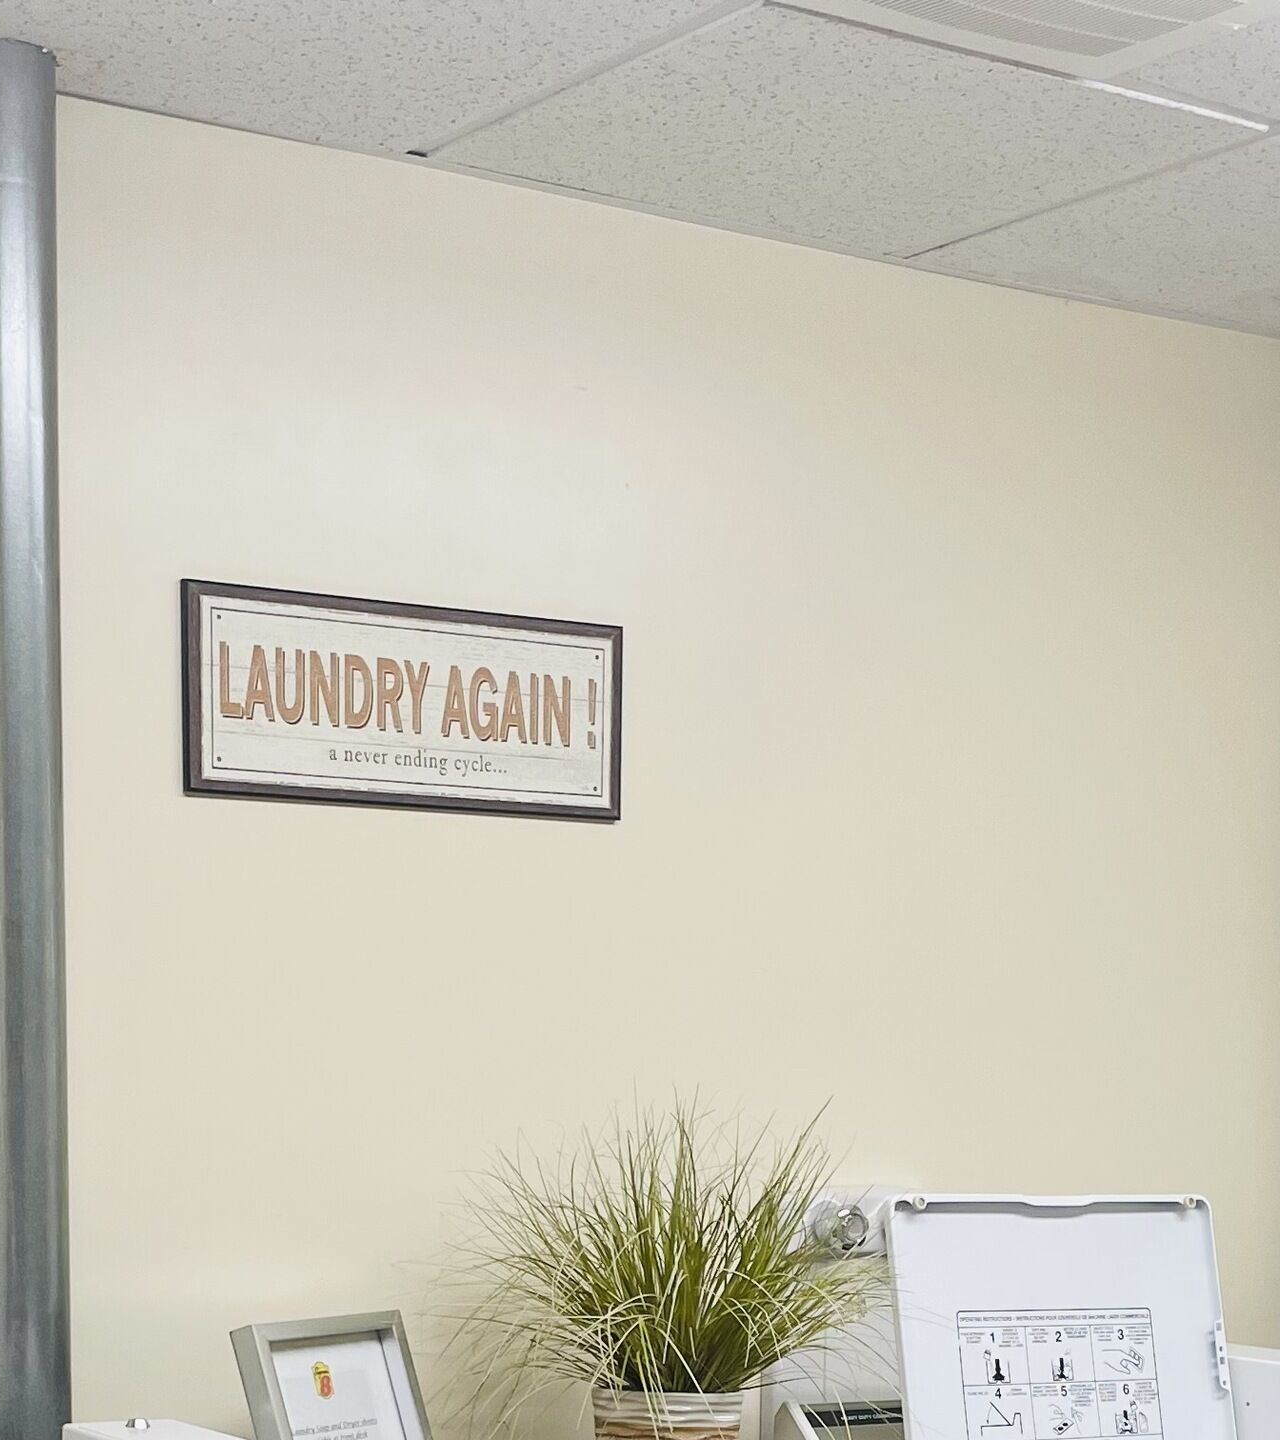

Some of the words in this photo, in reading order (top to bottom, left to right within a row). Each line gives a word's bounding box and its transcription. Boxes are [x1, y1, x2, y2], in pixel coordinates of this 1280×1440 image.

[220, 641, 430, 734] LAUNDRY
[441, 665, 572, 748] AGAIN
[328, 749, 337, 763] a
[344, 750, 389, 766] never
[394, 750, 449, 776] ending
[453, 754, 508, 776] cycle...
[990, 1332, 995, 1343] 1
[1055, 1331, 1062, 1342] 2
[1117, 1329, 1124, 1340] 3
[995, 1388, 1002, 1399] 4
[1061, 1386, 1068, 1397] 5
[1123, 1384, 1130, 1395] 6
